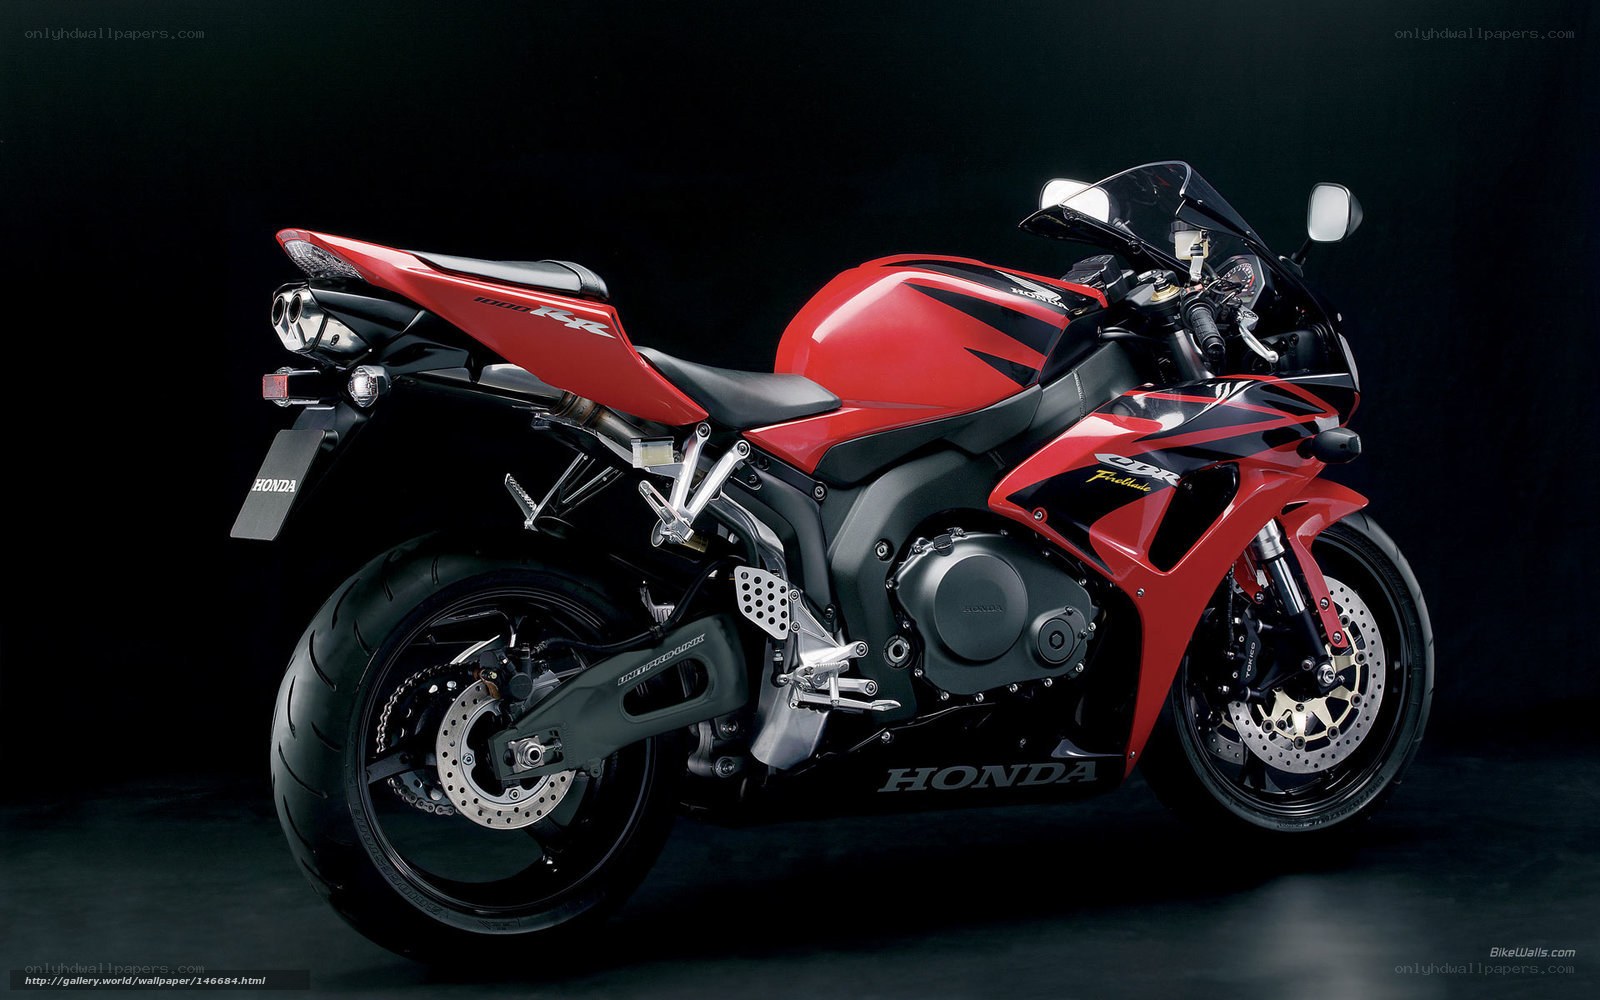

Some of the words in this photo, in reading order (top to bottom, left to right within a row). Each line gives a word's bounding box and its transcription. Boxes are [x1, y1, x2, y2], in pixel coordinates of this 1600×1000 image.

[473, 297, 531, 313] 1000
[530, 305, 616, 339] RR
[251, 479, 297, 492] HONDA
[1085, 469, 1152, 492] Fireblade
[1094, 453, 1181, 487] CBR
[877, 761, 1098, 792] HONDA
